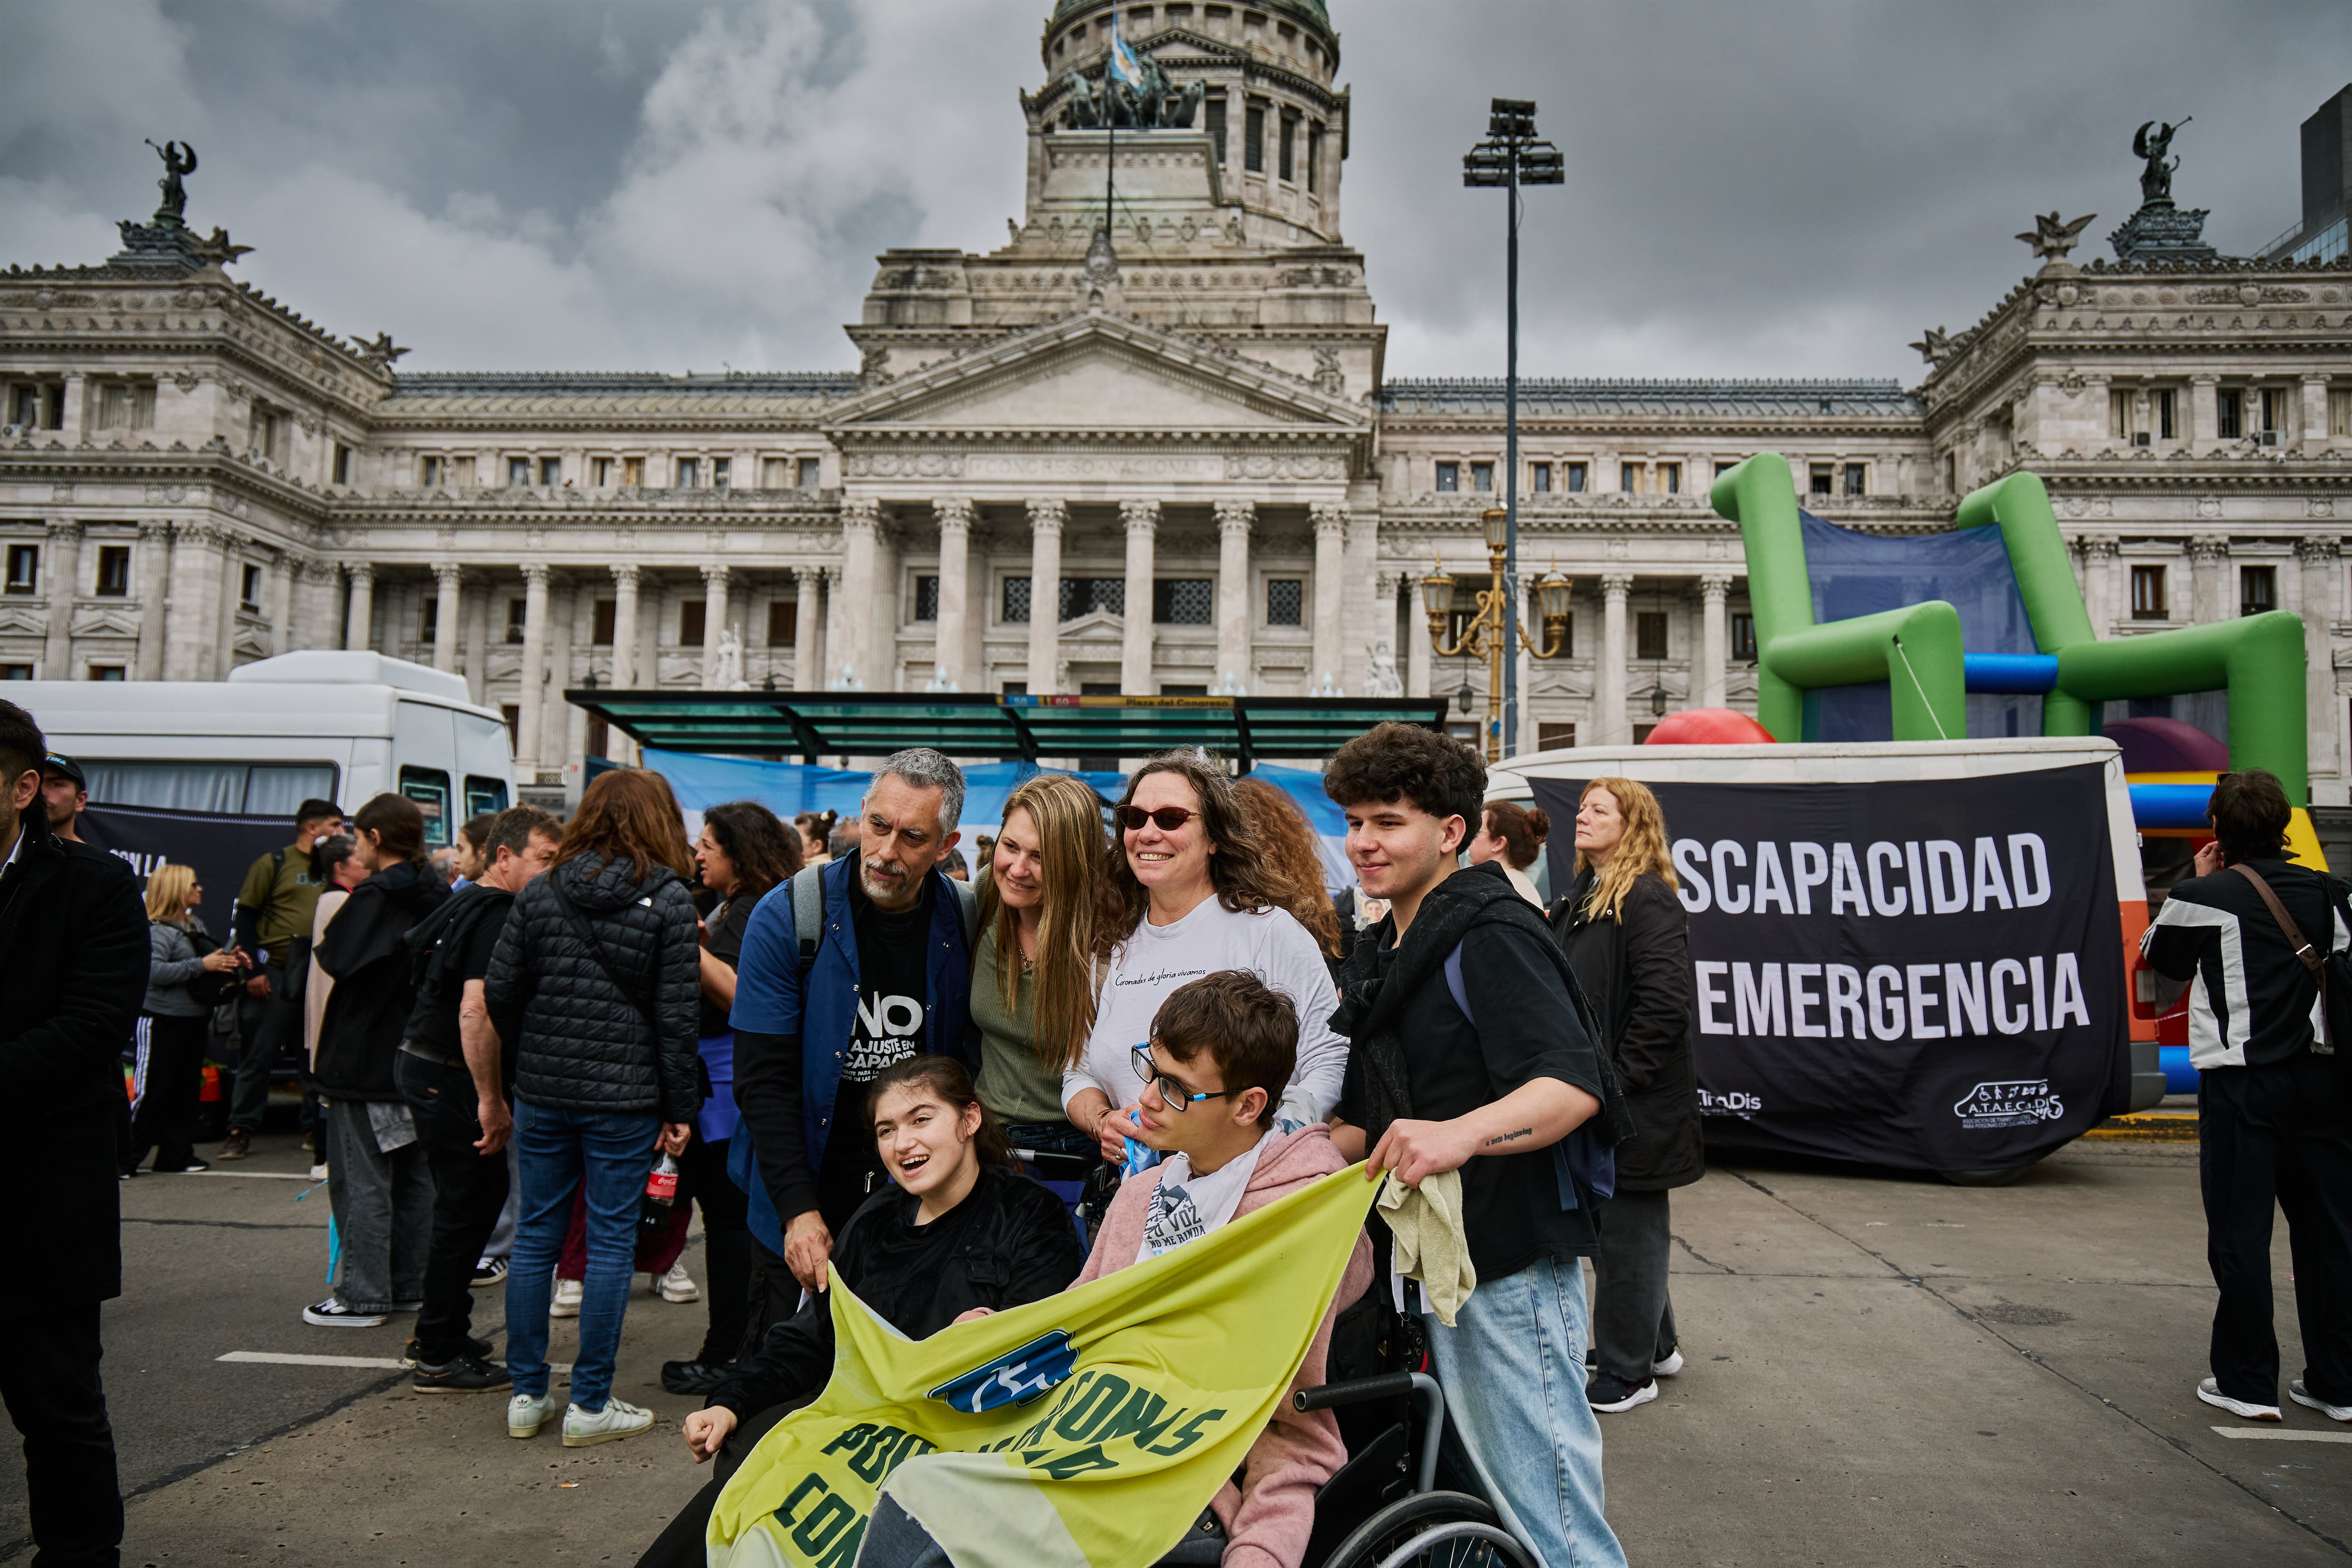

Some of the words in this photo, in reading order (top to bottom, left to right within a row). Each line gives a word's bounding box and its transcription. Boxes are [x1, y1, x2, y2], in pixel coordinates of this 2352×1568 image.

[1671, 832, 2051, 917] SCAPACIDAD
[1115, 974, 1146, 986] Coronadxs
[1147, 971, 1155, 982] de
[1154, 968, 1176, 986] gloria
[1695, 952, 2091, 1041] EMERGENCIA
[850, 991, 923, 1038] NO
[850, 1038, 901, 1054] AJUSTE
[901, 1040, 915, 1051] EN
[1491, 1135, 1503, 1145] new
[1148, 1239, 1162, 1249] NO
[1162, 1235, 1177, 1247] ME
[1177, 1225, 1206, 1243] RINDA
